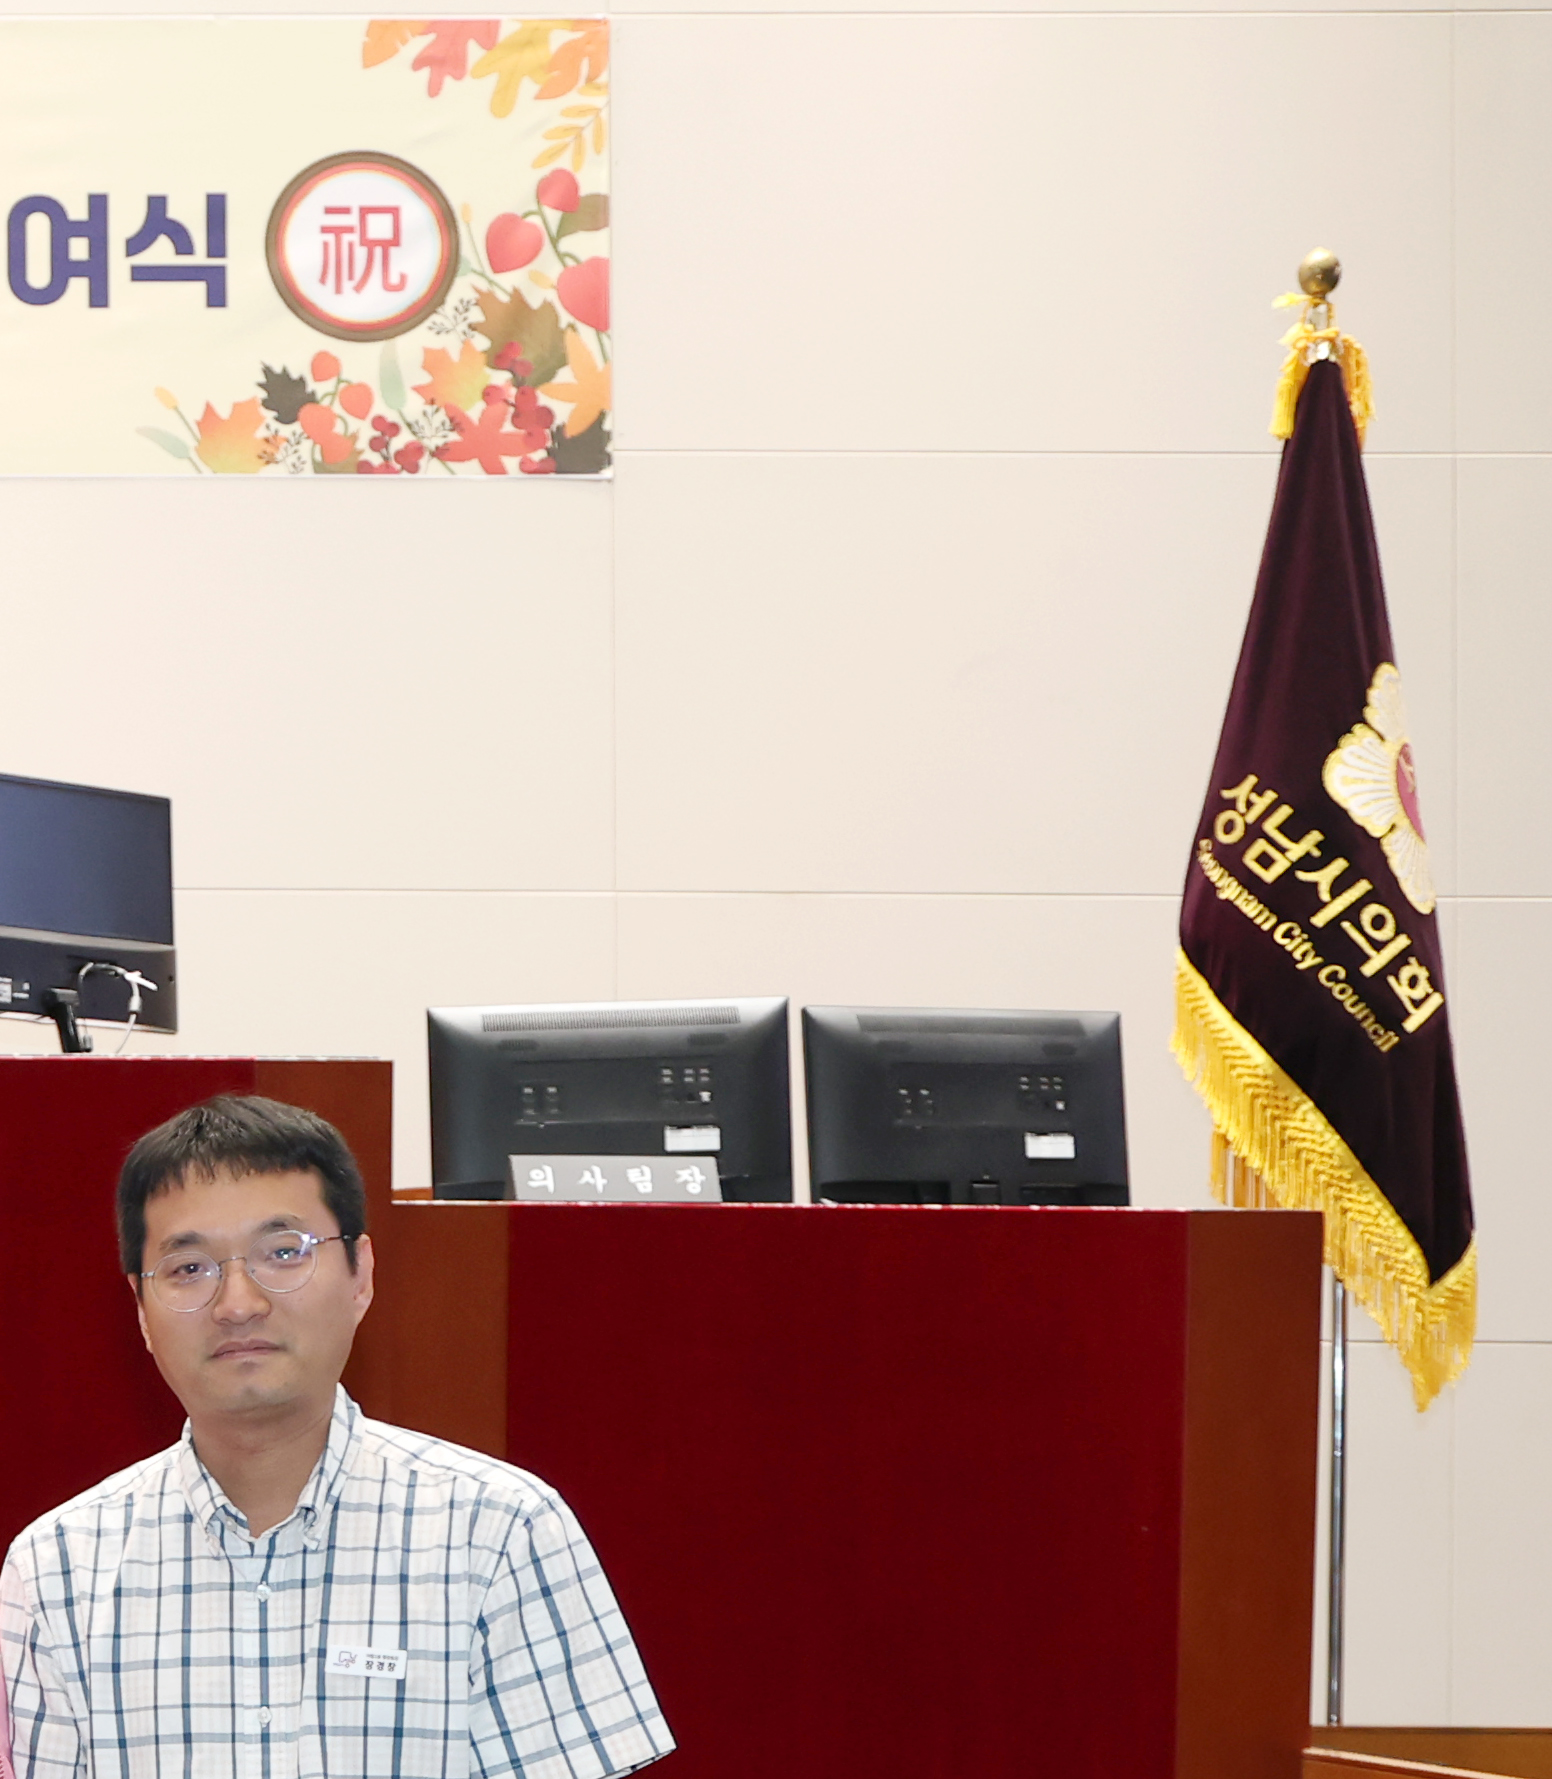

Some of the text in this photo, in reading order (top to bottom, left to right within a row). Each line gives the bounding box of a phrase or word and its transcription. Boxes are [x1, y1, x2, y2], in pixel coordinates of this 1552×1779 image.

[318, 205, 408, 296] 祝
[1213, 774, 1444, 1034] 성남시의회
[1272, 921, 1324, 971] City
[1317, 964, 1400, 1054] Council
